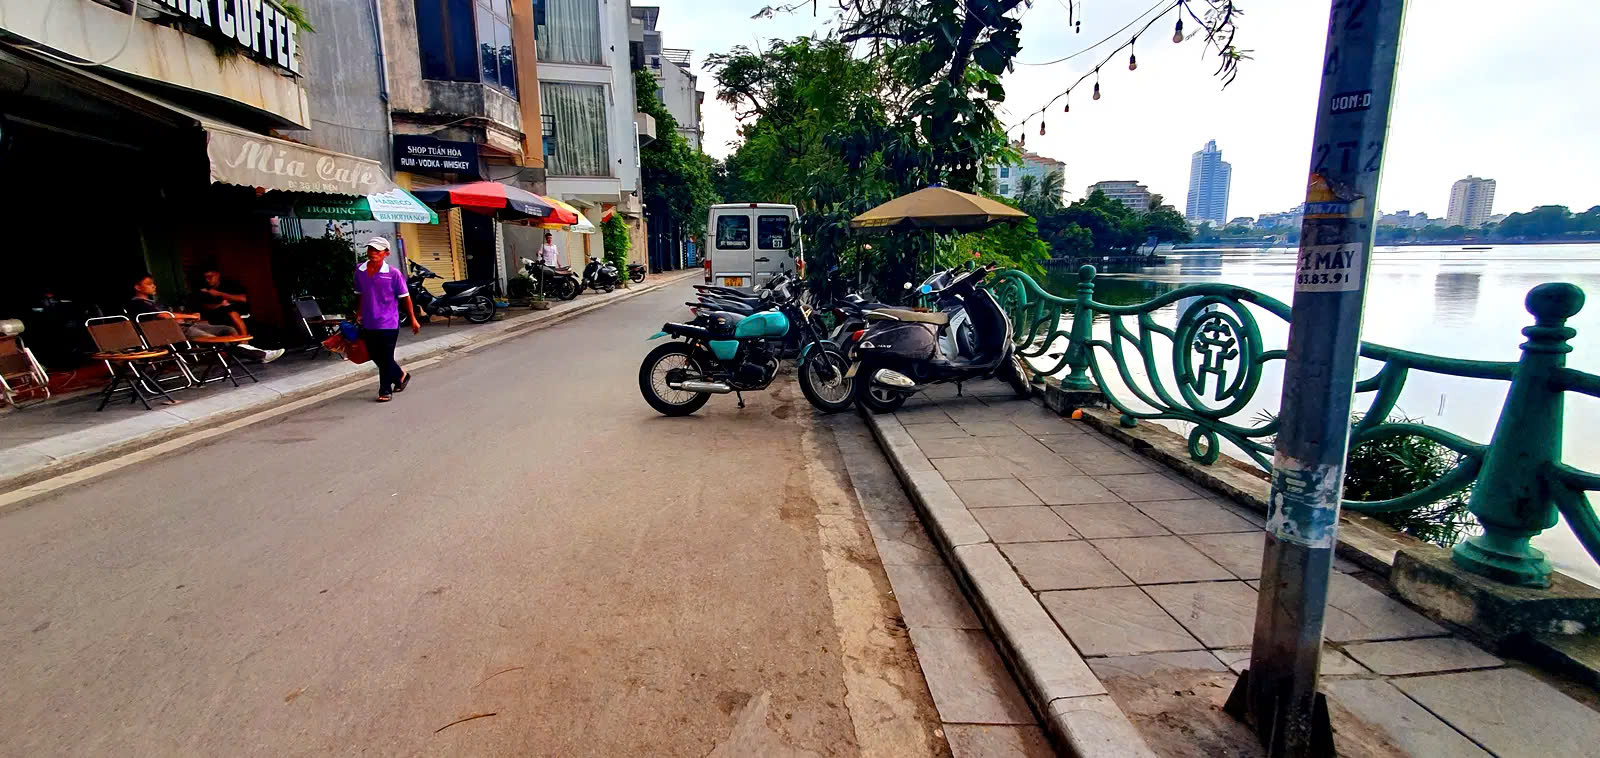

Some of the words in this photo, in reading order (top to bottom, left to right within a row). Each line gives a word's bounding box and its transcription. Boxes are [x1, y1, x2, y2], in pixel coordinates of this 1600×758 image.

[217, 0, 299, 73] COFFEE
[225, 140, 309, 177] Mia
[407, 145, 427, 154] SHOP
[400, 158, 415, 166] RUM
[418, 159, 440, 168] VODKA
[443, 160, 470, 170] WHISKEY
[306, 205, 356, 215] TRADING
[1314, 246, 1355, 270] MÁY
